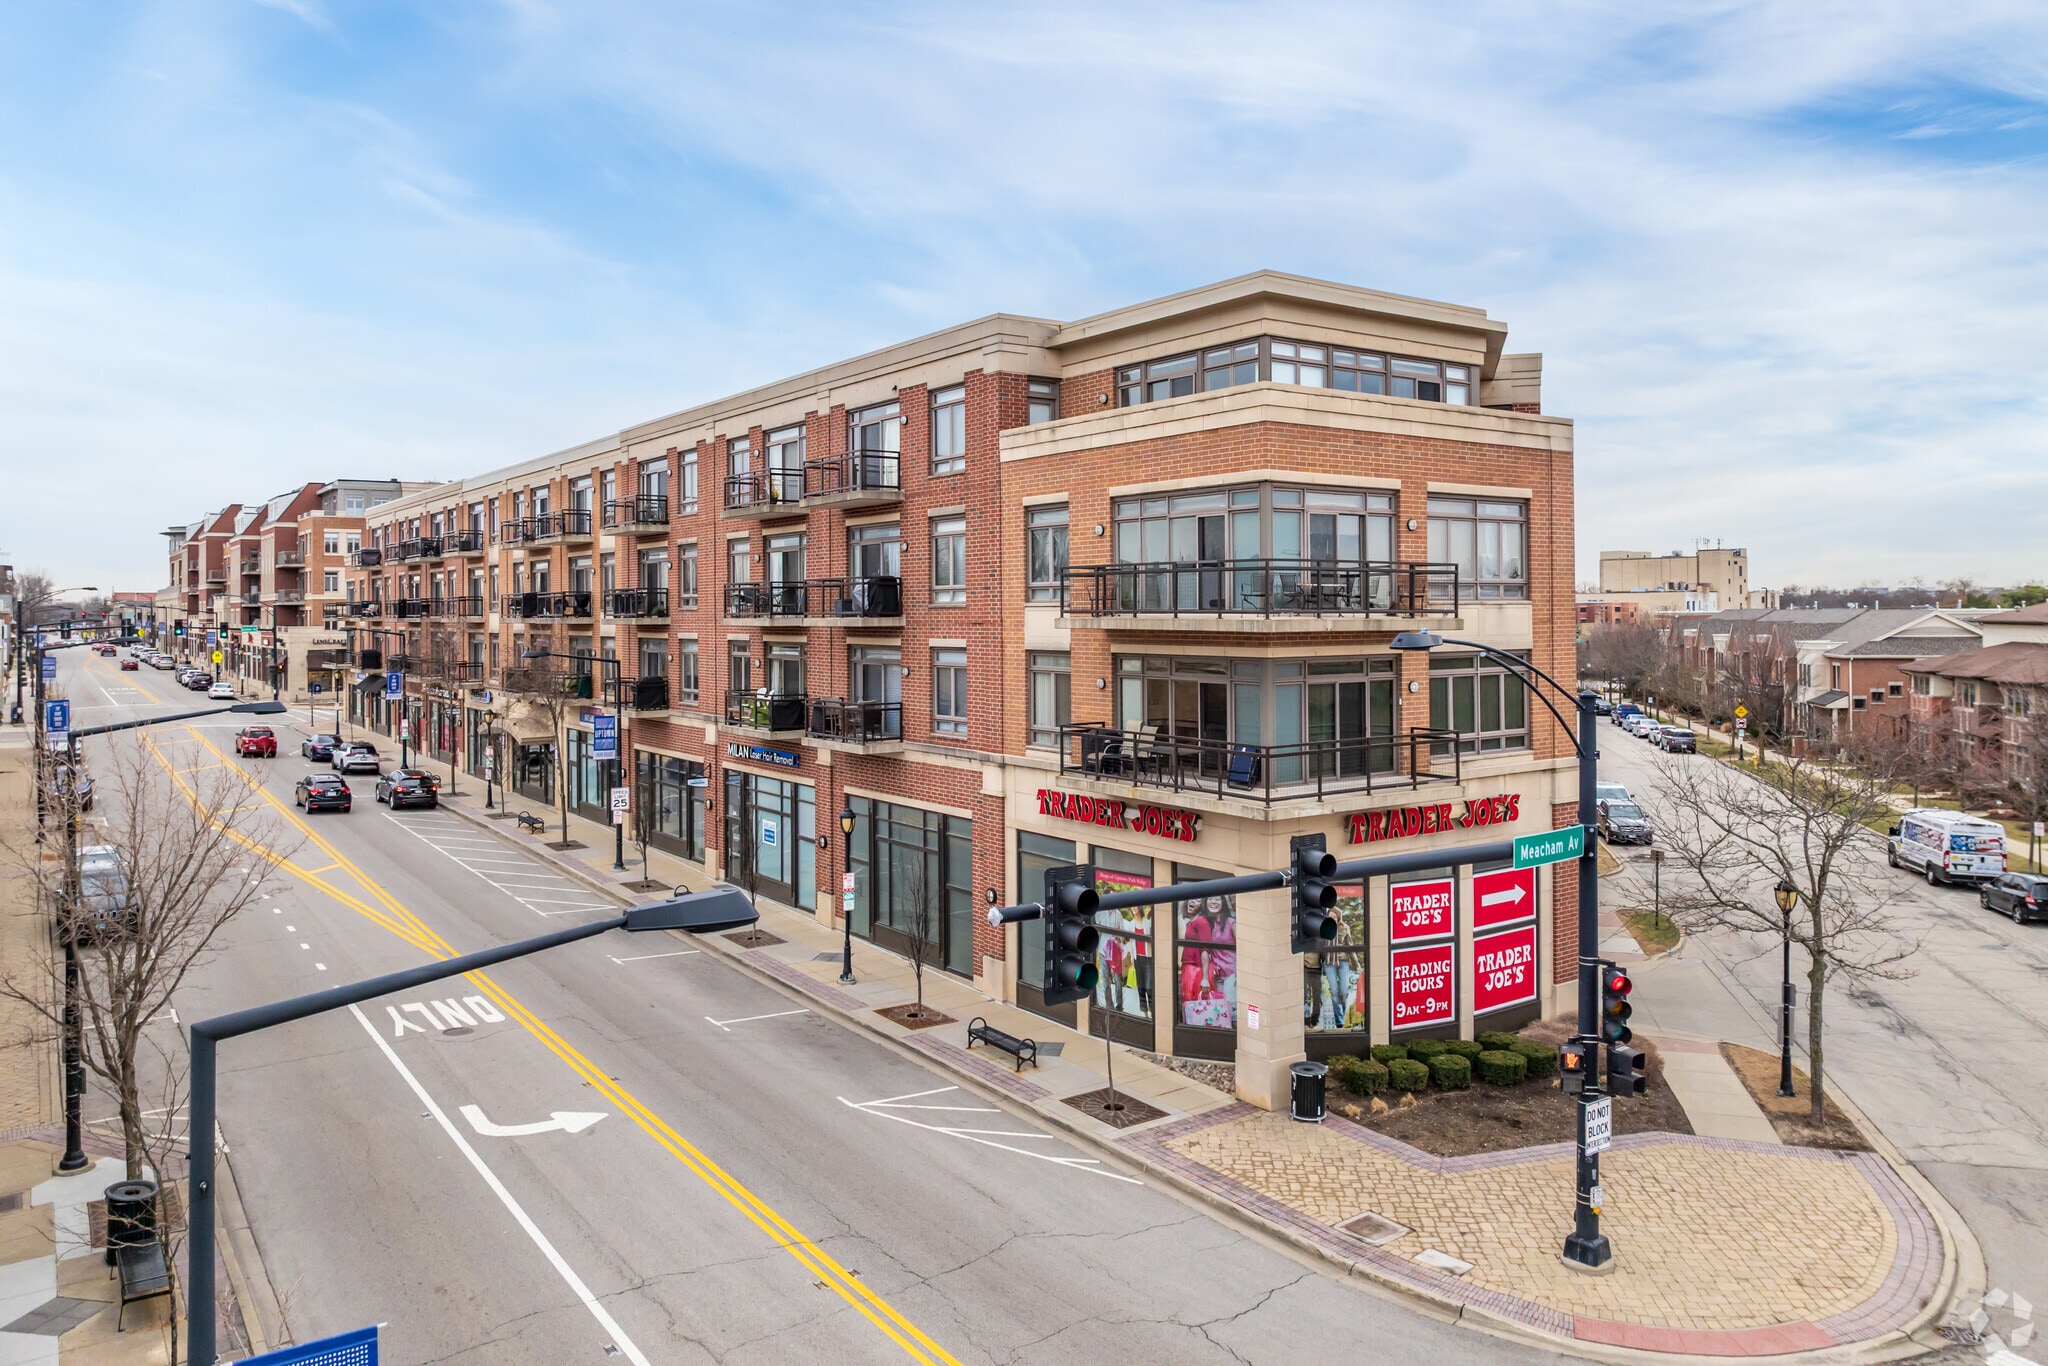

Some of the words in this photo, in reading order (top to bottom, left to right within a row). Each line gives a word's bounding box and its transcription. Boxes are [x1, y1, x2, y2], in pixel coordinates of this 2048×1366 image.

[727, 743, 749, 759] MILAN
[749, 748, 762, 760] Laser
[762, 751, 773, 761] Hair
[773, 752, 794, 766] Removal
[613, 799, 628, 808] 25
[1036, 789, 1125, 829] TRADER
[1131, 804, 1196, 842] JOE'S
[1350, 803, 1454, 844] TRADER
[1458, 794, 1521, 829] JOE'S
[1520, 840, 1564, 860] Meacham
[1568, 836, 1579, 851] Av
[1394, 893, 1449, 912] TRADER
[1401, 909, 1442, 927] JOE'S
[1477, 944, 1532, 973] TRADER
[1394, 960, 1450, 979] TRADING
[1485, 965, 1525, 991] JOE'S
[1401, 975, 1445, 993] HOURS
[385, 995, 506, 1037] ONLY
[1587, 1110, 1596, 1122] DO
[1597, 1105, 1609, 1118] NOT
[1588, 1122, 1609, 1138] BLOCK
[1587, 1136, 1611, 1149] INTERSECTION
